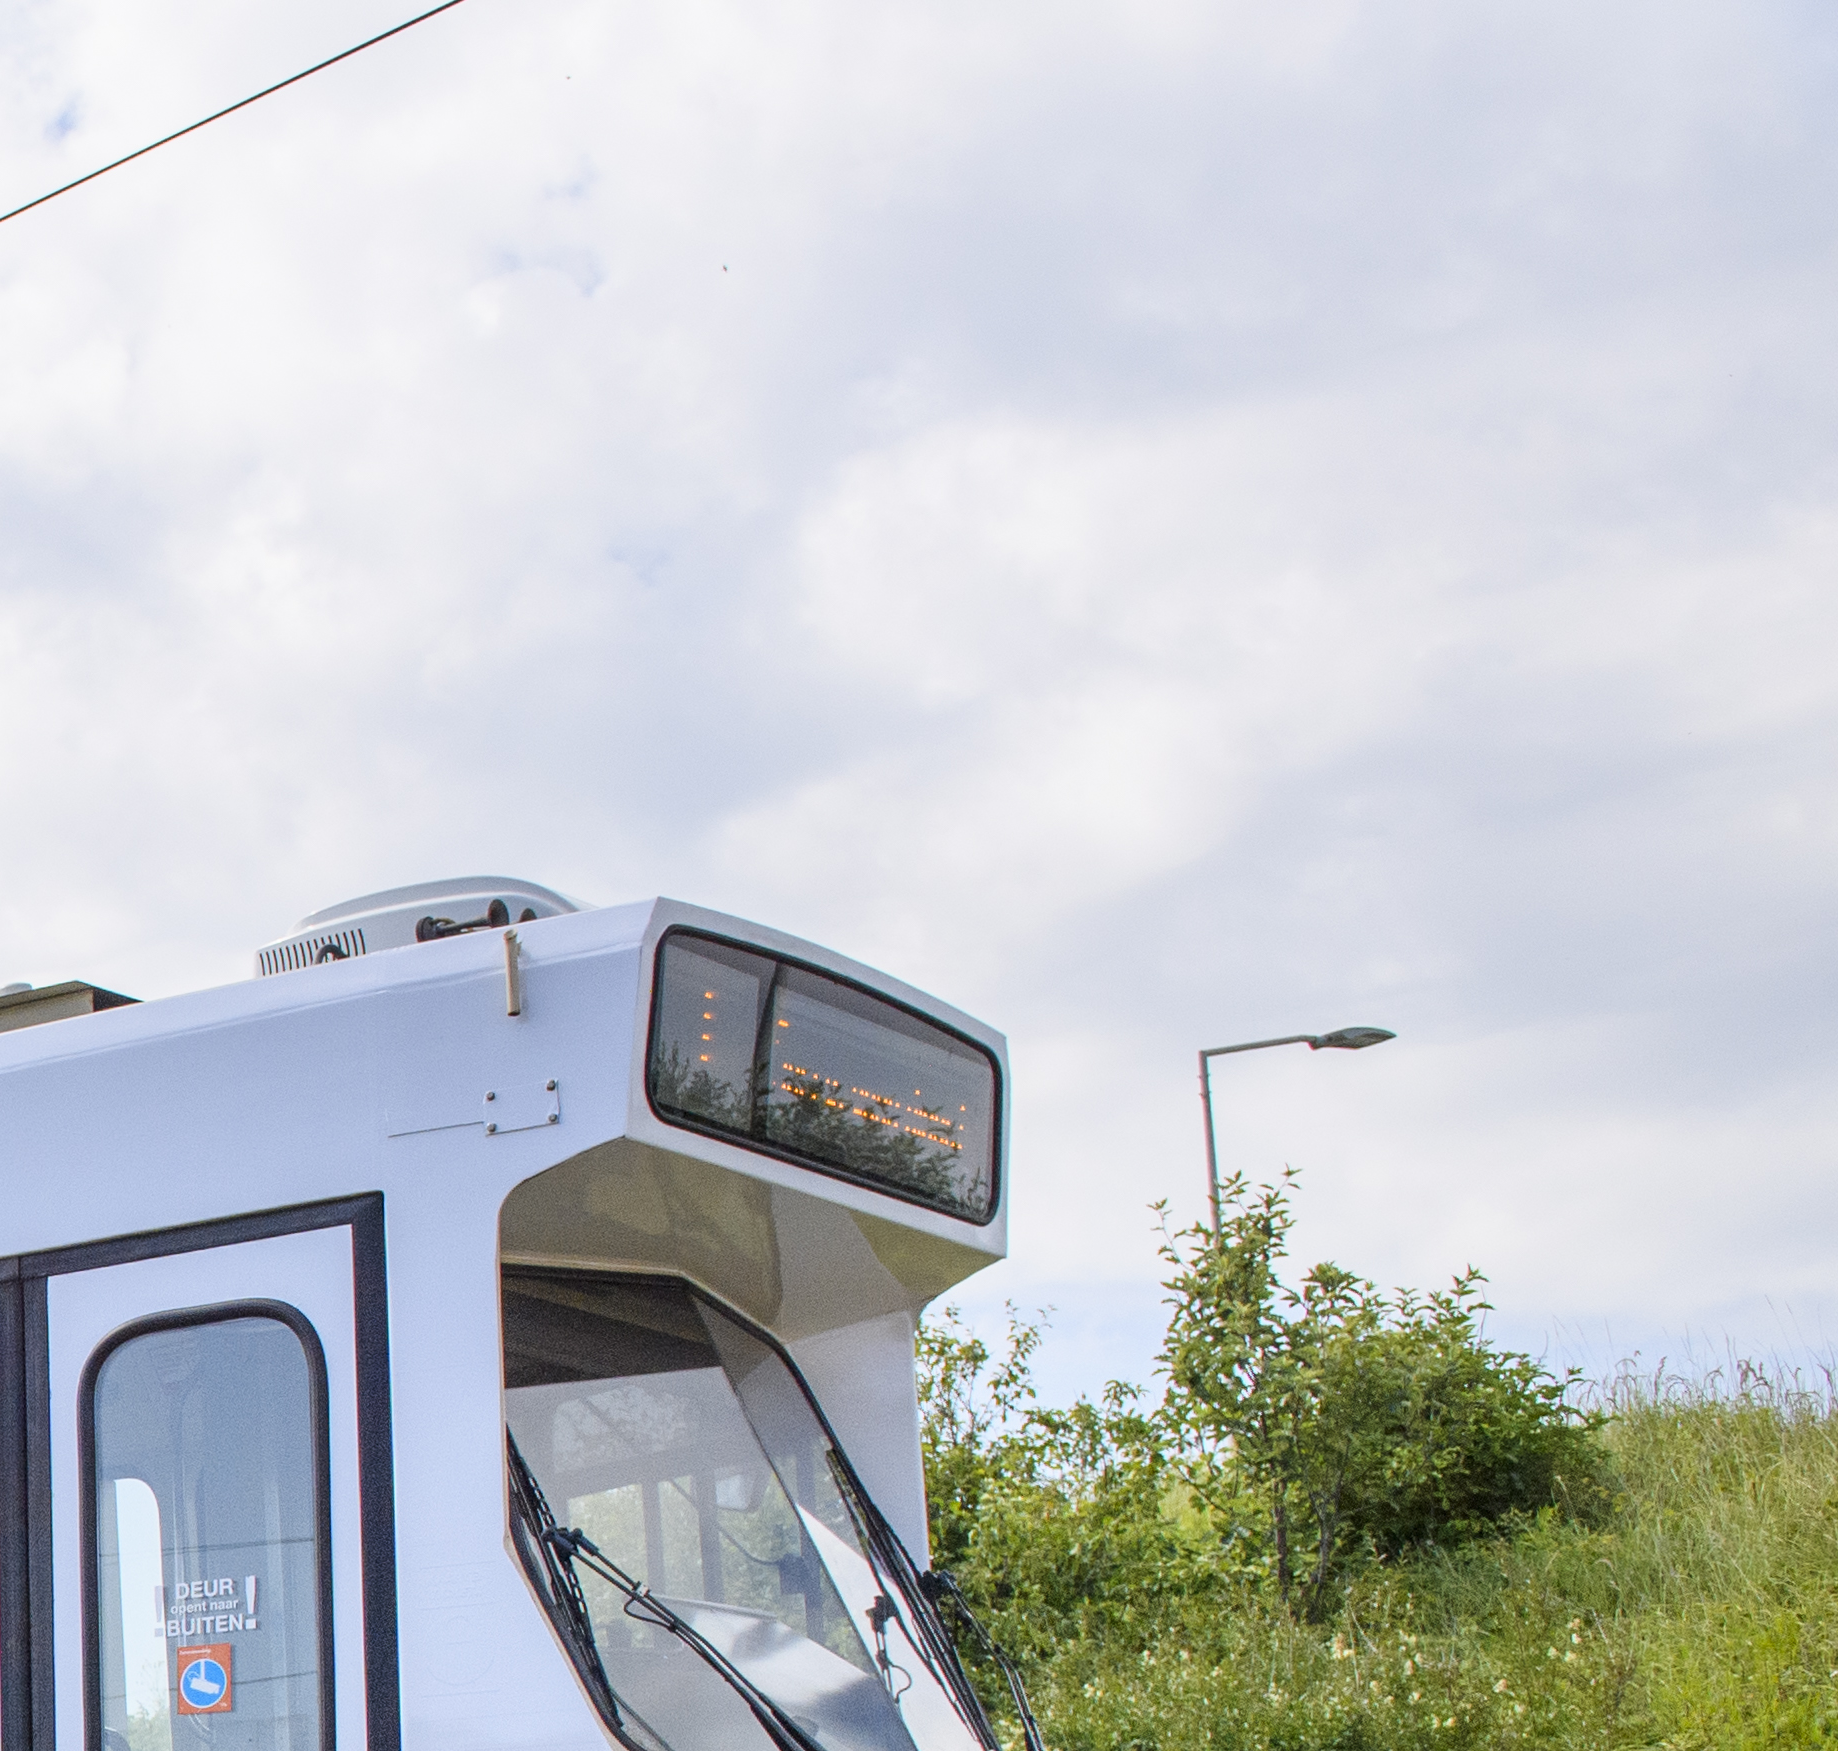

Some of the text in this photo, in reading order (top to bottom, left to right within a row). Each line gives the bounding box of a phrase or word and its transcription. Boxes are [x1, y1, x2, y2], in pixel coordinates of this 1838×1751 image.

[175, 1577, 235, 1600] DEUR
[170, 1598, 239, 1616] opent naar
